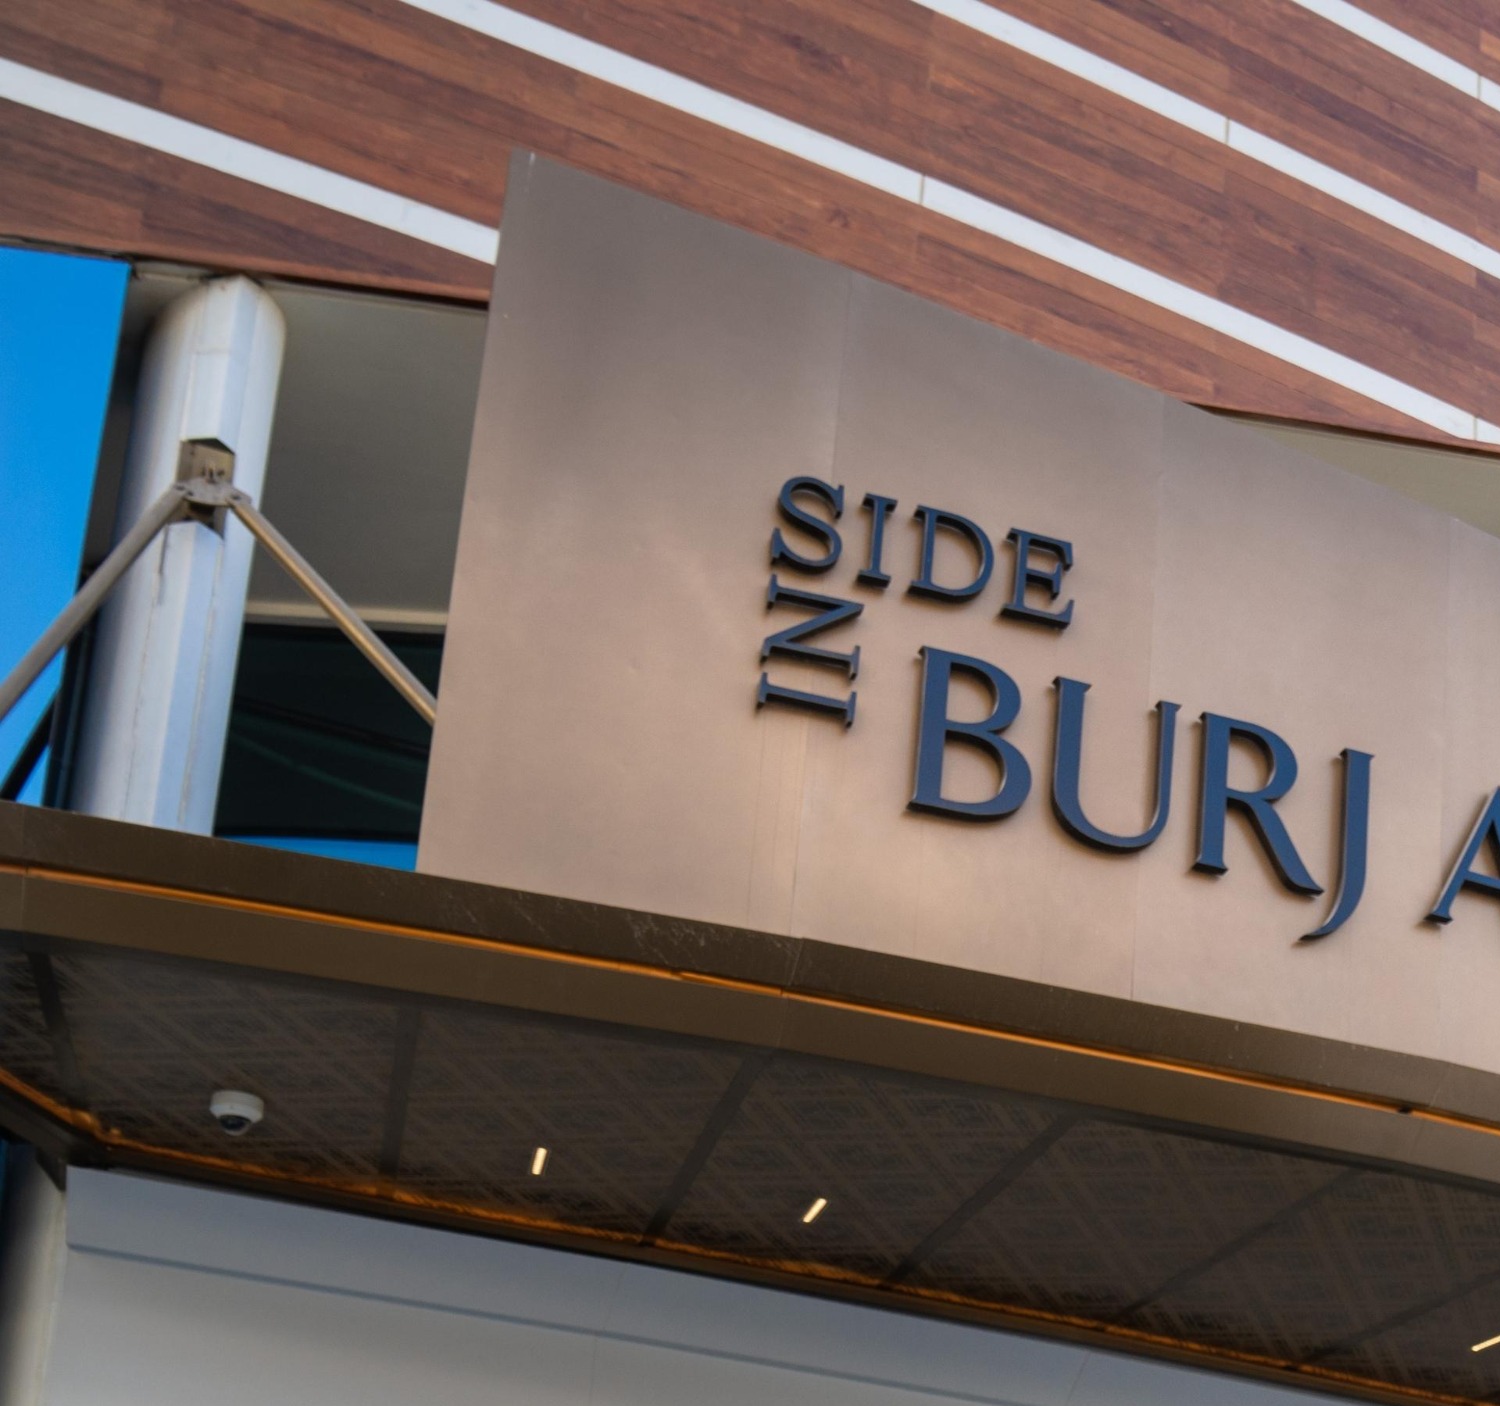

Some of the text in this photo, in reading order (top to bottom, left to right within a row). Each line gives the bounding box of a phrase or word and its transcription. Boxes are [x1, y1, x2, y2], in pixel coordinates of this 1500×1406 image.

[770, 476, 1075, 630] SIDE
[757, 574, 864, 731] IN
[905, 645, 1374, 944] BURJ
